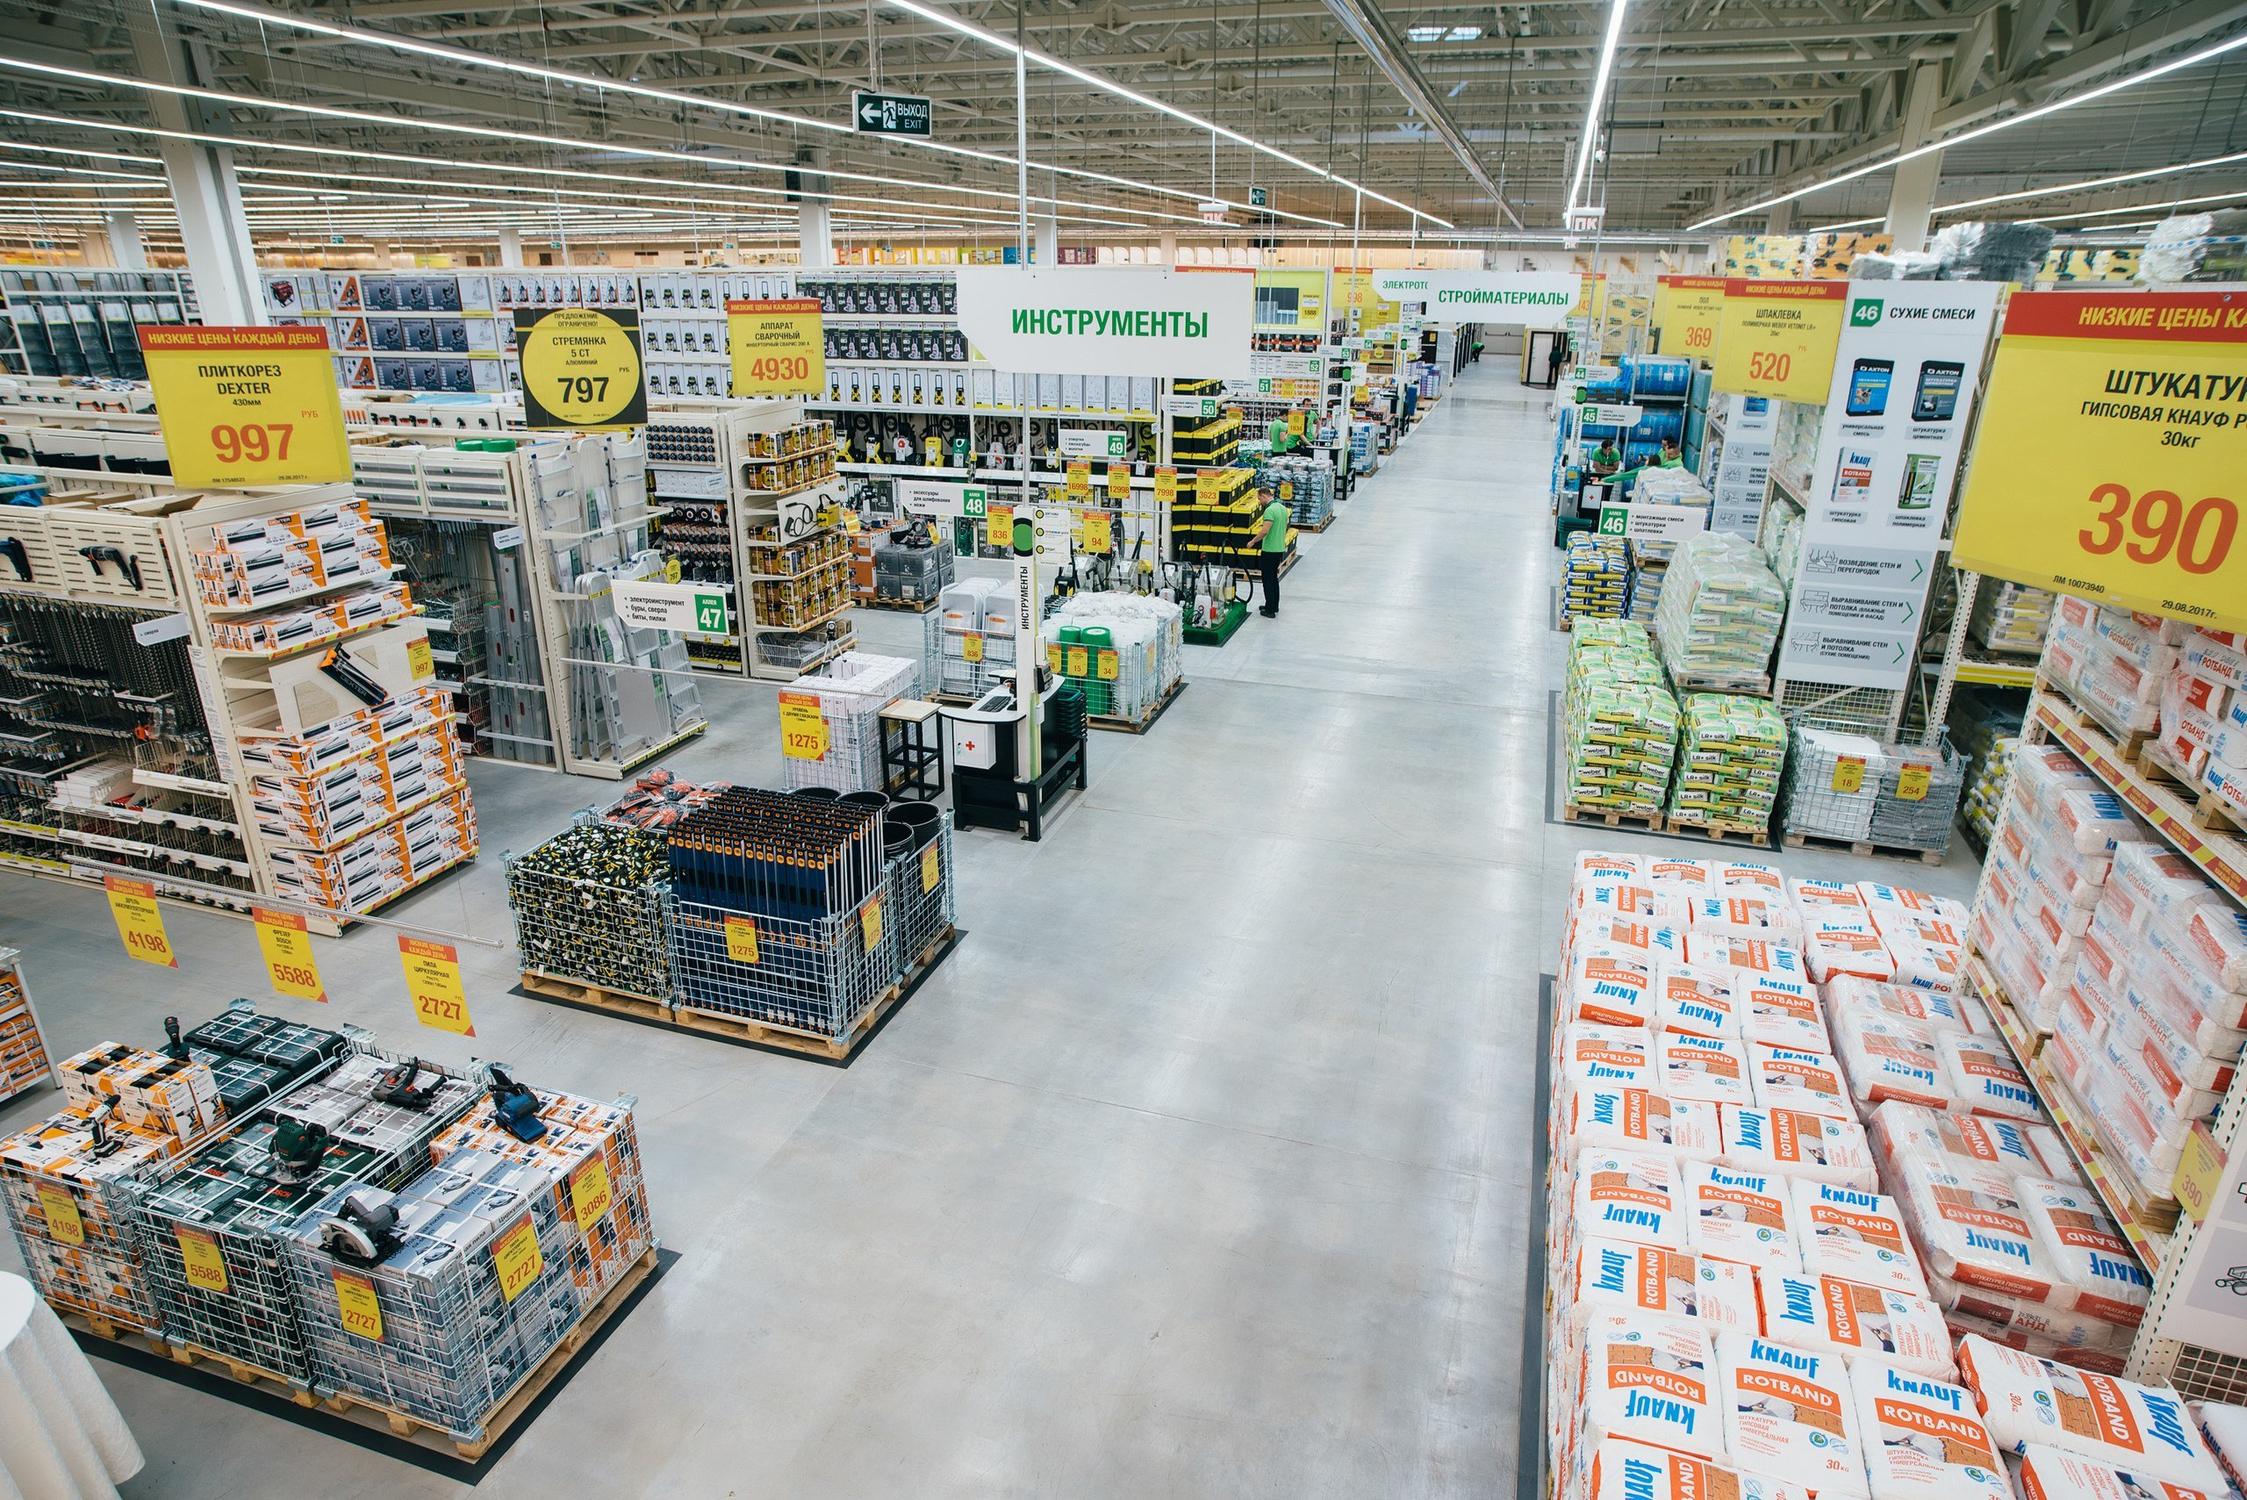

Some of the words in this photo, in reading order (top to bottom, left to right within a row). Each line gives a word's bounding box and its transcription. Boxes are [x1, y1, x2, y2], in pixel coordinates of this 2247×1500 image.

[897, 103, 928, 119] ВЫХОД
[905, 119, 922, 128] EXIT
[1438, 288, 1569, 305] СТРОЙМАТЕРИАЛЫ
[1765, 286, 1783, 295] ЦЕНЫ
[1783, 285, 1809, 295] КАЖДЫЙ
[773, 303, 801, 311] КАЖДЫЙ
[1756, 308, 1802, 320] ШПАКЛЕВКА
[1855, 305, 1879, 321] 46
[1889, 306, 1930, 319] СУХИЕ
[1932, 308, 1976, 320] СМЕСИ
[760, 322, 793, 330] АППАРАТ
[1012, 308, 1208, 338] ИНСТРУМЕНТЫ
[2078, 306, 2156, 327] НИЗКИЕ
[2157, 307, 2222, 330] ЦЕНЫ
[148, 334, 195, 344] НИЗКИЕ
[199, 334, 230, 345] ЦЕНЫ
[233, 332, 285, 346] КАЖДЫЙ
[288, 334, 320, 345] ДЕНЬ!
[552, 337, 607, 346] СТРЕМЯНКА
[755, 331, 800, 340] СВАРОЧНЫЙ
[1685, 326, 1712, 348] 369
[571, 349, 577, 358] 5
[579, 349, 590, 358] СТ
[198, 365, 282, 378] ПЛИТКОРЕЗ
[751, 357, 809, 381] 4930
[1749, 351, 1791, 382] 520
[1935, 368, 1960, 376] AXTON
[217, 382, 271, 395] DEXTER
[557, 376, 609, 404] 797
[1260, 383, 1270, 392] 51
[232, 398, 262, 407] 430мм
[1202, 405, 1215, 416] 50
[301, 409, 319, 418] РУБ
[1583, 411, 1596, 423] 45
[2080, 401, 2164, 423] ГИПСОВАЯ
[2166, 408, 2230, 428] КНАУФ
[2233, 413, 2247, 429] Р
[211, 424, 294, 464] 997
[1110, 442, 1123, 454] 49
[2161, 430, 2202, 449] 30кг
[1849, 452, 1871, 468] KNAUF
[1068, 483, 1089, 491] 16998
[1156, 488, 1174, 497] 7998
[1199, 491, 1217, 500] 3623
[965, 498, 984, 514] 48
[1603, 517, 1624, 533] 46
[2078, 483, 2239, 575] 390
[992, 530, 1008, 540] 836
[1091, 537, 1102, 546] 94
[1837, 567, 1880, 576] ПЕРЕГОРОДОК
[1839, 559, 1878, 568] ВОЗВЕДЕНИЕ
[2052, 575, 2066, 585] ЛМ
[2068, 578, 2105, 594] 10073940
[629, 596, 685, 607] электроинструмент
[1021, 566, 1029, 630] ИНСТРУМЕНТЫ
[1831, 596, 1880, 606] ВЫРАВНИВАНИЕ
[1829, 604, 1858, 612] ПОТОЛКА
[2161, 599, 2218, 620] 29.08.2017г.
[700, 608, 721, 629] 47
[1822, 637, 1872, 647] ВЫРАВНИВАНИЕ
[415, 662, 429, 673] 997
[2201, 656, 2233, 679] РОТБАНД
[1653, 721, 1671, 730] weber
[787, 733, 819, 750] 1275
[1842, 778, 1852, 787] 18
[1902, 786, 1920, 795] 254
[128, 929, 167, 953] 4198
[731, 943, 755, 957] 1275
[272, 963, 316, 988] 5588
[1592, 981, 1638, 1005] KNAUF
[1759, 977, 1803, 995] KNAUF
[418, 995, 461, 1021] 2727
[1678, 1001, 1723, 1028] KNAUF
[1678, 1034, 1726, 1051] KNAUF
[1587, 1062, 1635, 1081] KNAUF
[1710, 1167, 1767, 1193] KNAUF
[1820, 1183, 1880, 1212] KNAUF
[2182, 1175, 2204, 1208] 390
[580, 1191, 608, 1221] 3086
[1602, 1203, 1661, 1234] KNAUF
[1816, 1209, 1894, 1233] ROTBAND
[52, 1217, 79, 1238] 4198
[1965, 1227, 2031, 1266] KNAUF
[190, 1264, 222, 1283] 5588
[506, 1254, 536, 1292] 2727
[1592, 1248, 1632, 1293] KNAUF
[1779, 1277, 1817, 1325] KNAUF
[346, 1309, 376, 1331] 2727
[1750, 1339, 1820, 1380] KNAUF
[1613, 1369, 1700, 1400] ROTBAND
[1742, 1373, 1832, 1407] ROTBAND
[1888, 1369, 1962, 1411] KNAUF
[1625, 1390, 1696, 1435] KNAUF
[2091, 1375, 2130, 1440] ROTBAND
[1883, 1405, 1981, 1441] ROTBAND
[2138, 1389, 2195, 1458] KNAUF
